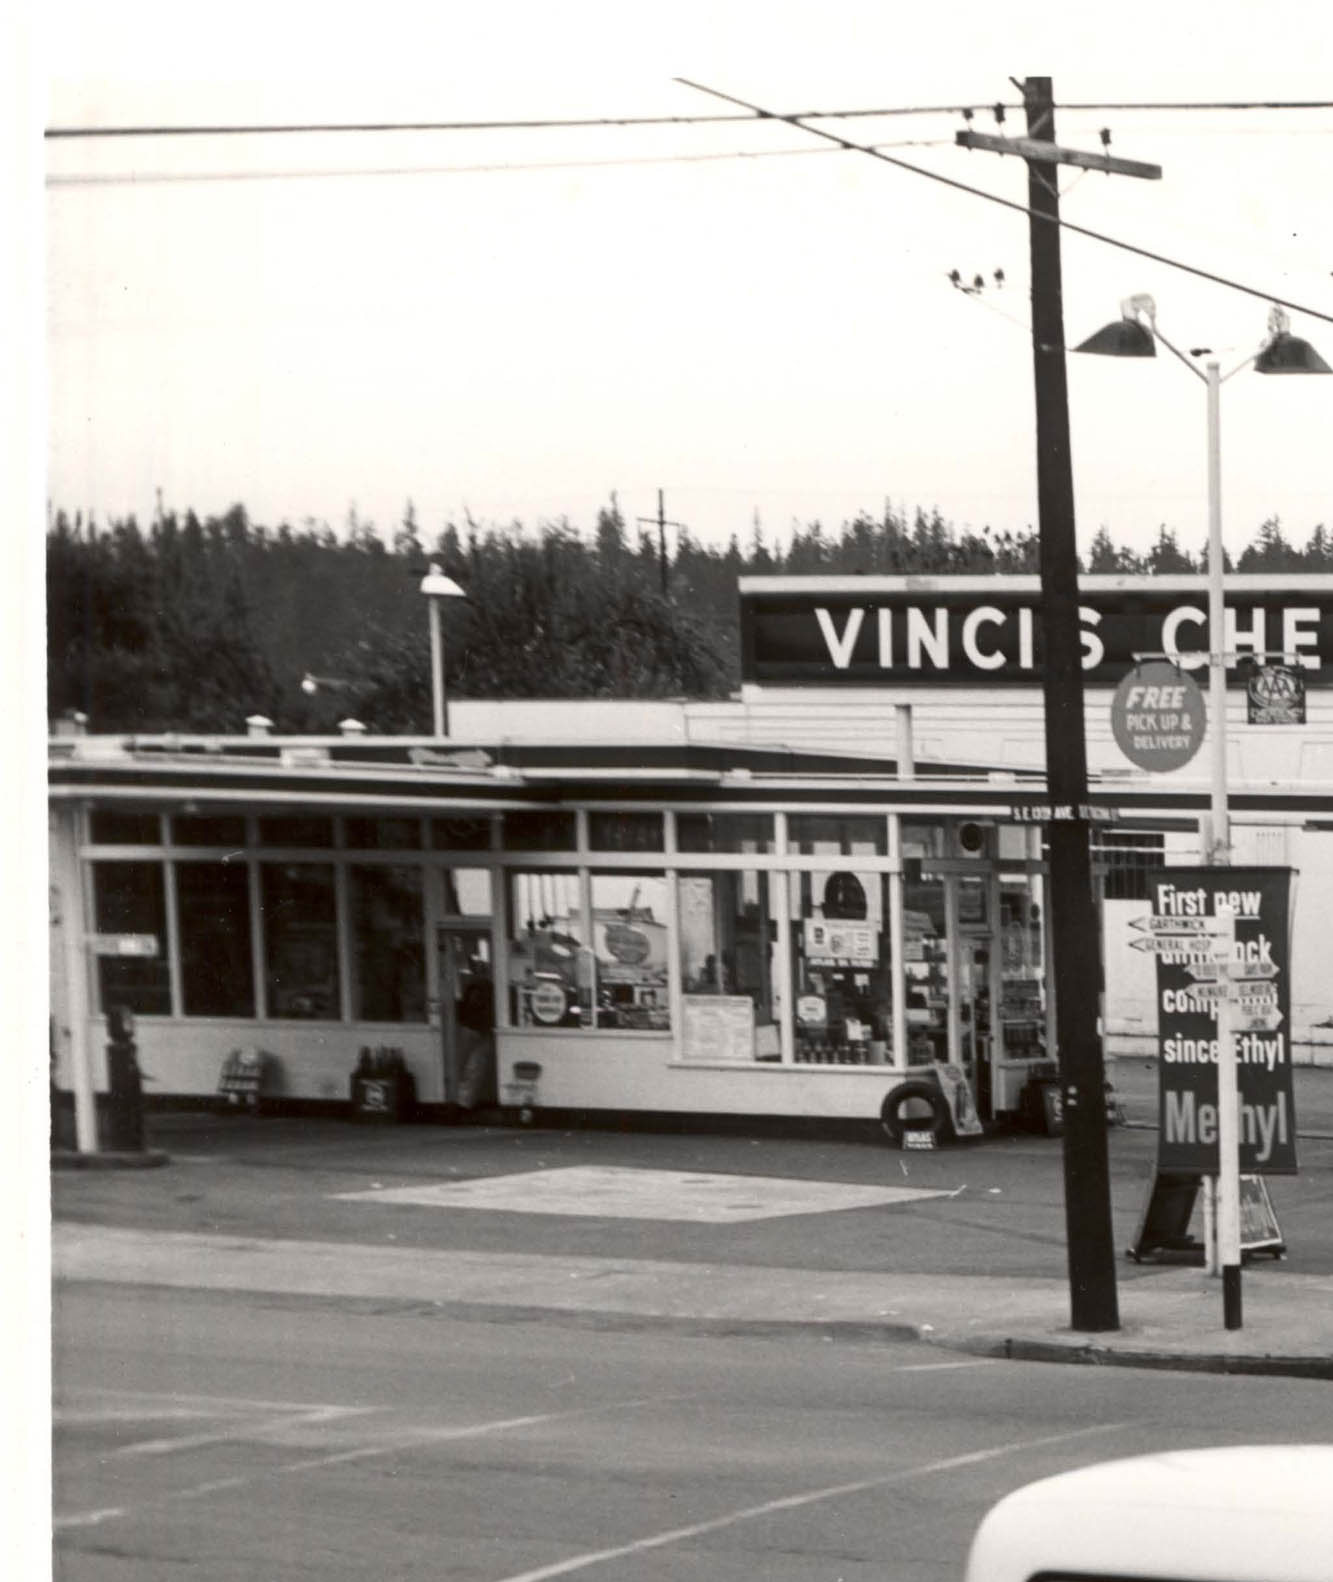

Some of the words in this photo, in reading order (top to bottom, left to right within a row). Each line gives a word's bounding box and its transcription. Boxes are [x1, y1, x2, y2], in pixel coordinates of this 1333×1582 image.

[1126, 686, 1187, 709] FREE
[1126, 713, 1157, 731] PICK
[1159, 713, 1178, 730] UP
[1181, 713, 1192, 730] &
[1133, 735, 1191, 750] DELIVERY
[1157, 884, 1208, 915] First
[1163, 1032, 1218, 1063] since
[1234, 1032, 1284, 1071] Ethyl
[1166, 1091, 1287, 1162] Mehyl
